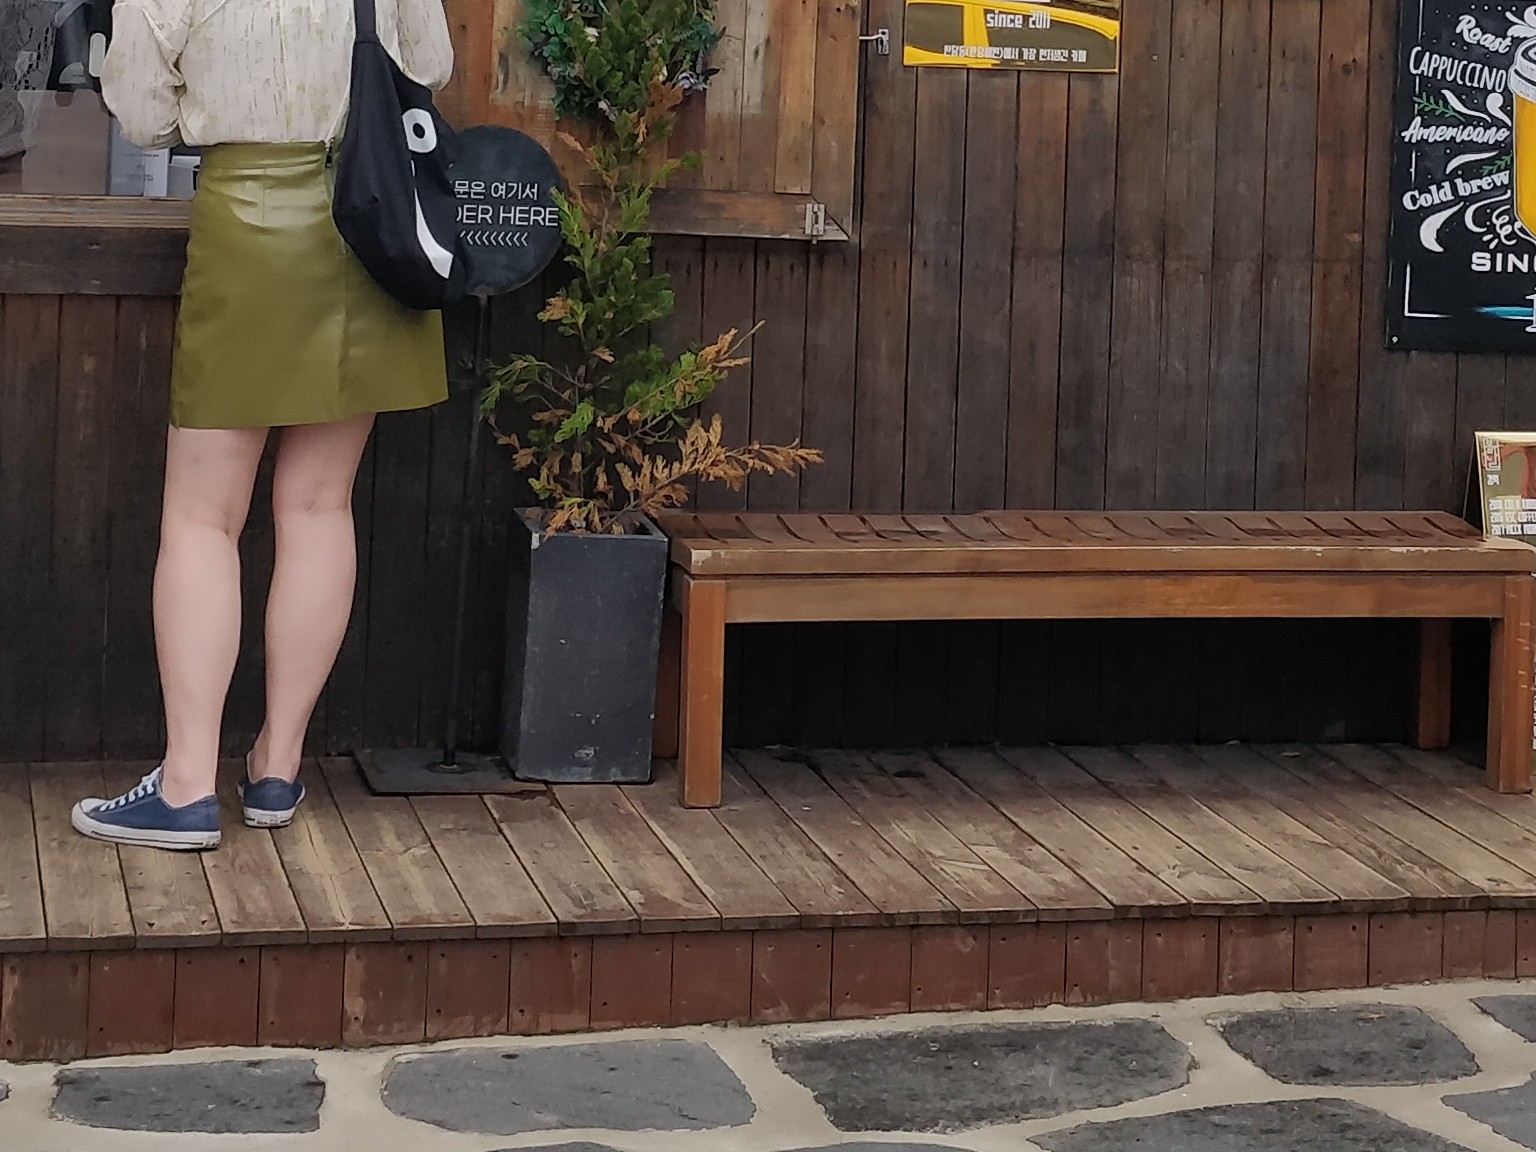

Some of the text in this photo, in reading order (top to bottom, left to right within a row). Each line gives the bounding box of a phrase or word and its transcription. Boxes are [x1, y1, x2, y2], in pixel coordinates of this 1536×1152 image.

[986, 9, 1052, 30] since 2011
[1455, 14, 1513, 54] Roast
[1409, 46, 1507, 93] CAPPUCCINO
[1401, 115, 1511, 145] Americano
[491, 181, 539, 200] 여기서
[1402, 169, 1512, 211] Cold brew
[499, 206, 560, 227] HERE
